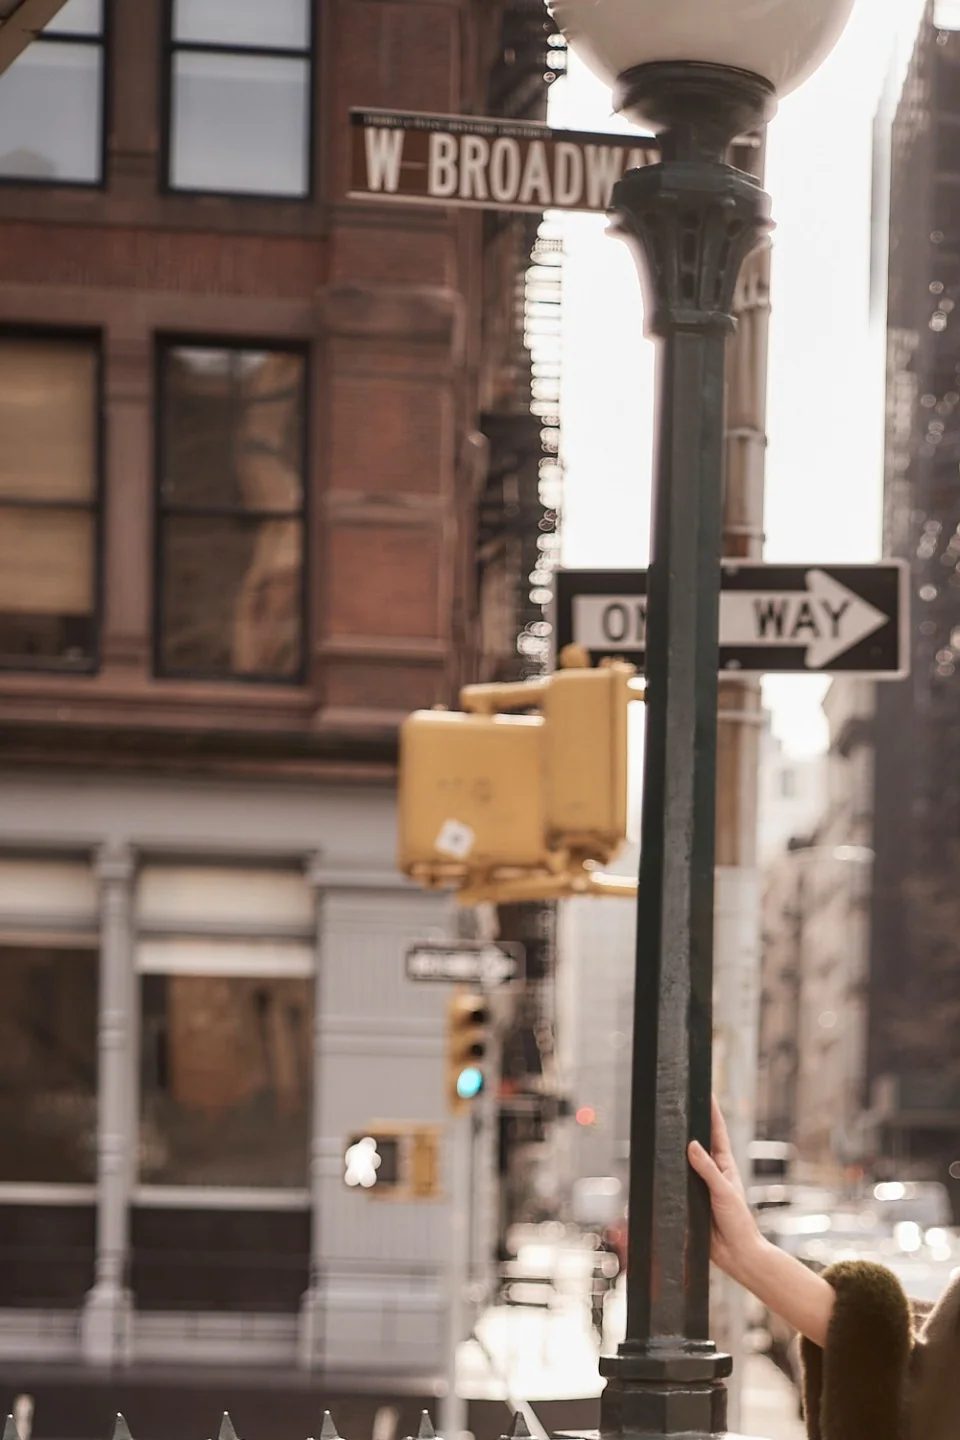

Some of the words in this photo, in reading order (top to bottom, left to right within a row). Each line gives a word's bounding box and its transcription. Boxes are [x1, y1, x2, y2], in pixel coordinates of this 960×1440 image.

[364, 127, 404, 192] W
[428, 132, 661, 208] BROADW
[754, 600, 851, 639] WAY
